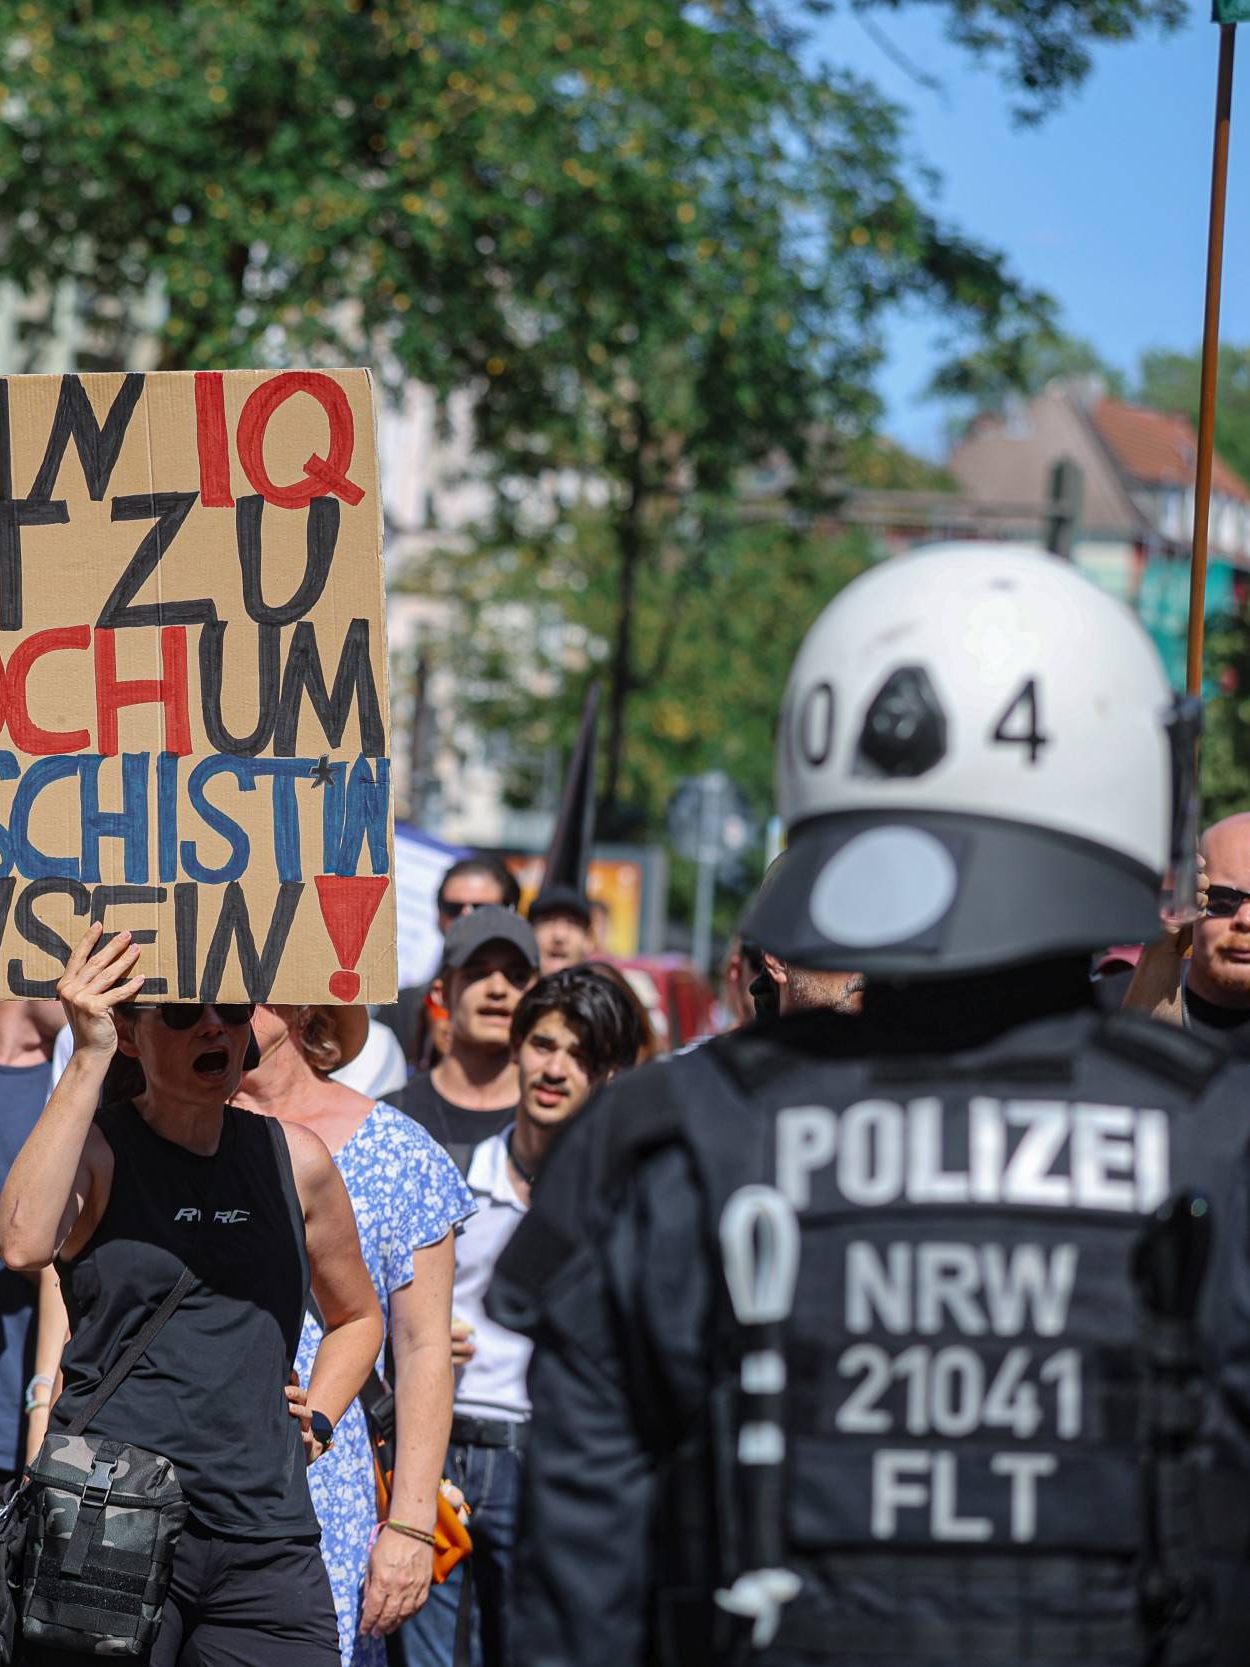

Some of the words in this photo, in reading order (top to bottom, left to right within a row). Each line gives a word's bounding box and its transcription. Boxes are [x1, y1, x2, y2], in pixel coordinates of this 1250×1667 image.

[195, 371, 366, 509] IQ
[95, 491, 340, 629] ZU
[199, 618, 385, 758] UM
[989, 675, 1050, 767] 4
[775, 1096, 1171, 1214] POLIZEI
[845, 1240, 1079, 1337] NRW
[835, 1343, 1083, 1440] 21041
[870, 1448, 1057, 1544] FLT
